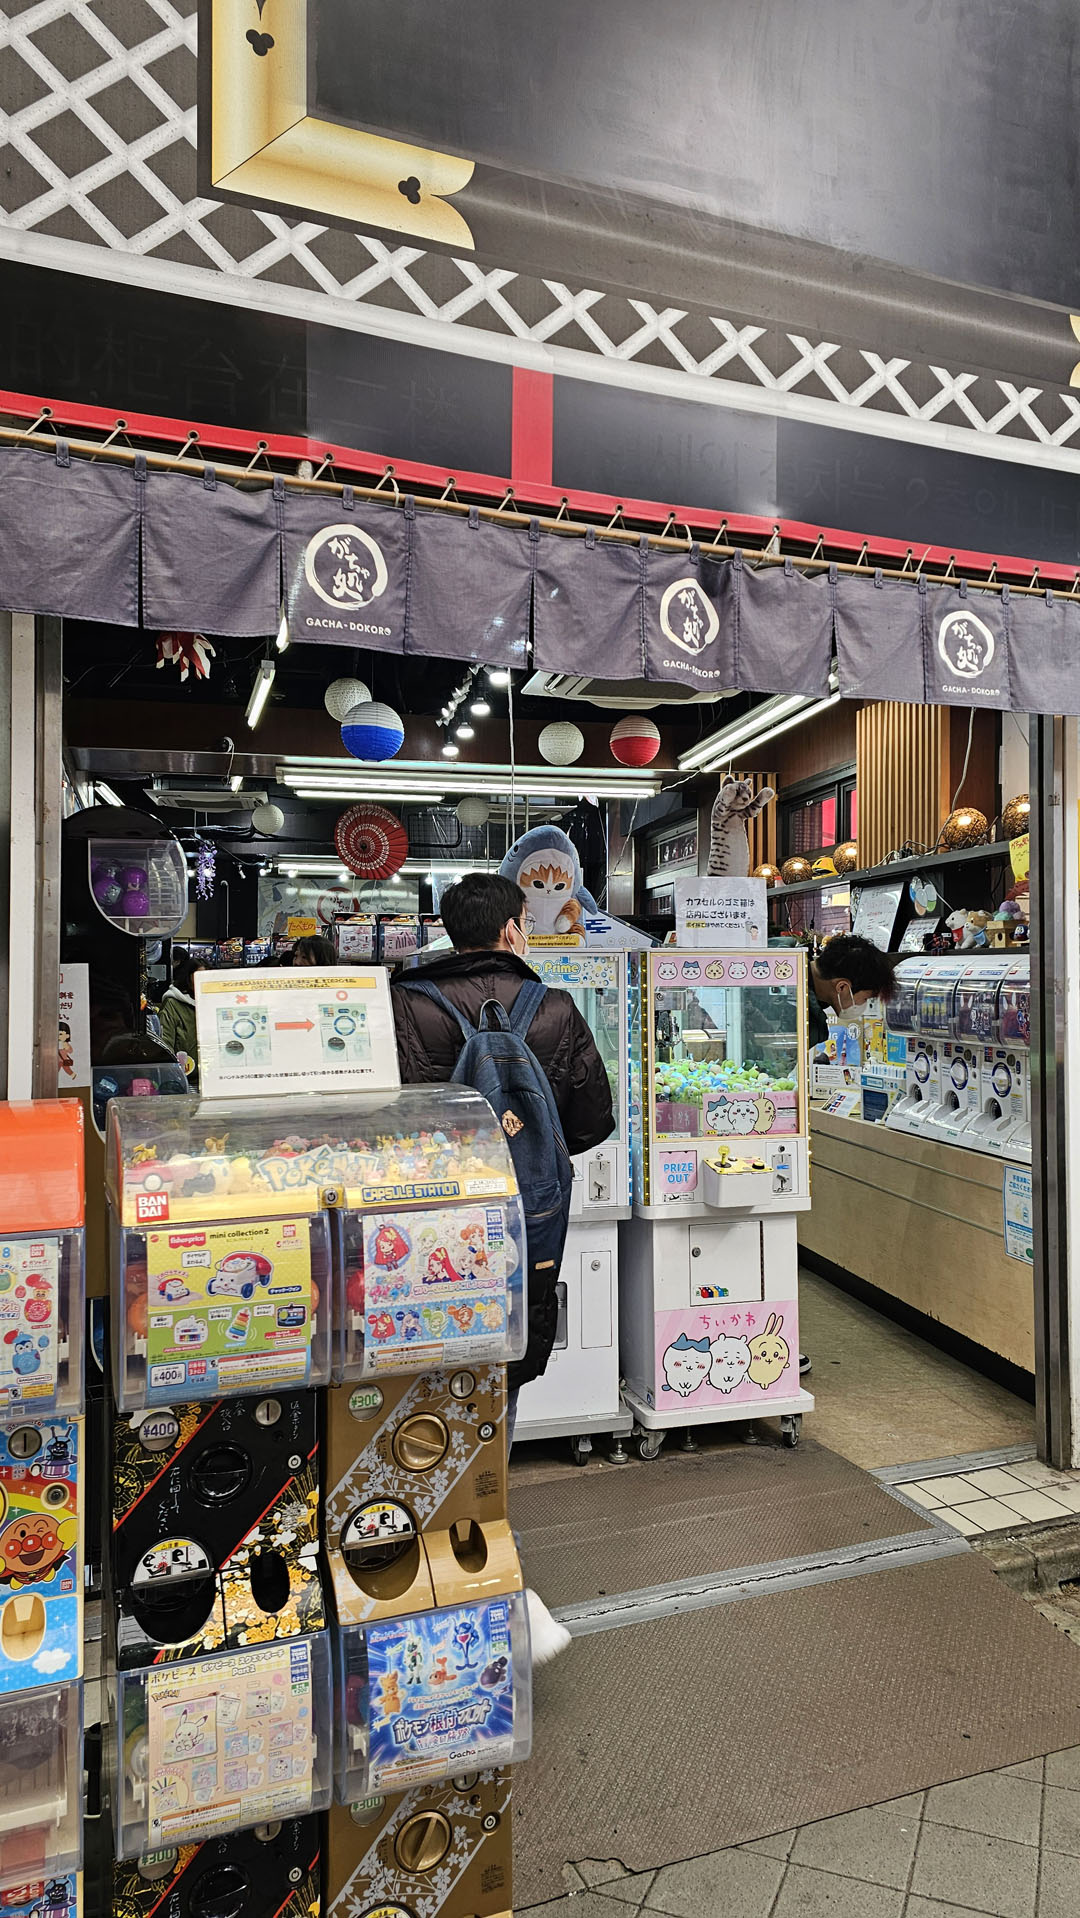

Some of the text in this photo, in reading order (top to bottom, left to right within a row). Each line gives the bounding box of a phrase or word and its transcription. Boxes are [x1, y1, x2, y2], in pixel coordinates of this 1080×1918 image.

[328, 537, 370, 601] がちゃ処
[686, 897, 755, 908] カプセルのゴミ箱は
[686, 910, 751, 920] 店内にございます。
[288, 920, 316, 932] たべもの
[544, 960, 580, 974] Prime
[664, 1162, 694, 1174] PRIZE
[667, 1173, 690, 1185] OUT
[363, 1185, 414, 1202] CAPSULE
[414, 1181, 461, 1198] STATION
[138, 1195, 167, 1208] BAN
[139, 1206, 162, 1218] DAI
[209, 1231, 226, 1240] mini
[228, 1229, 263, 1240] collection
[263, 1228, 270, 1236] 2
[700, 1312, 756, 1330] ちいかわ
[143, 1421, 176, 1438] ¥400
[151, 1667, 197, 1684] ポケピース
[449, 1749, 477, 1761] Gacha
